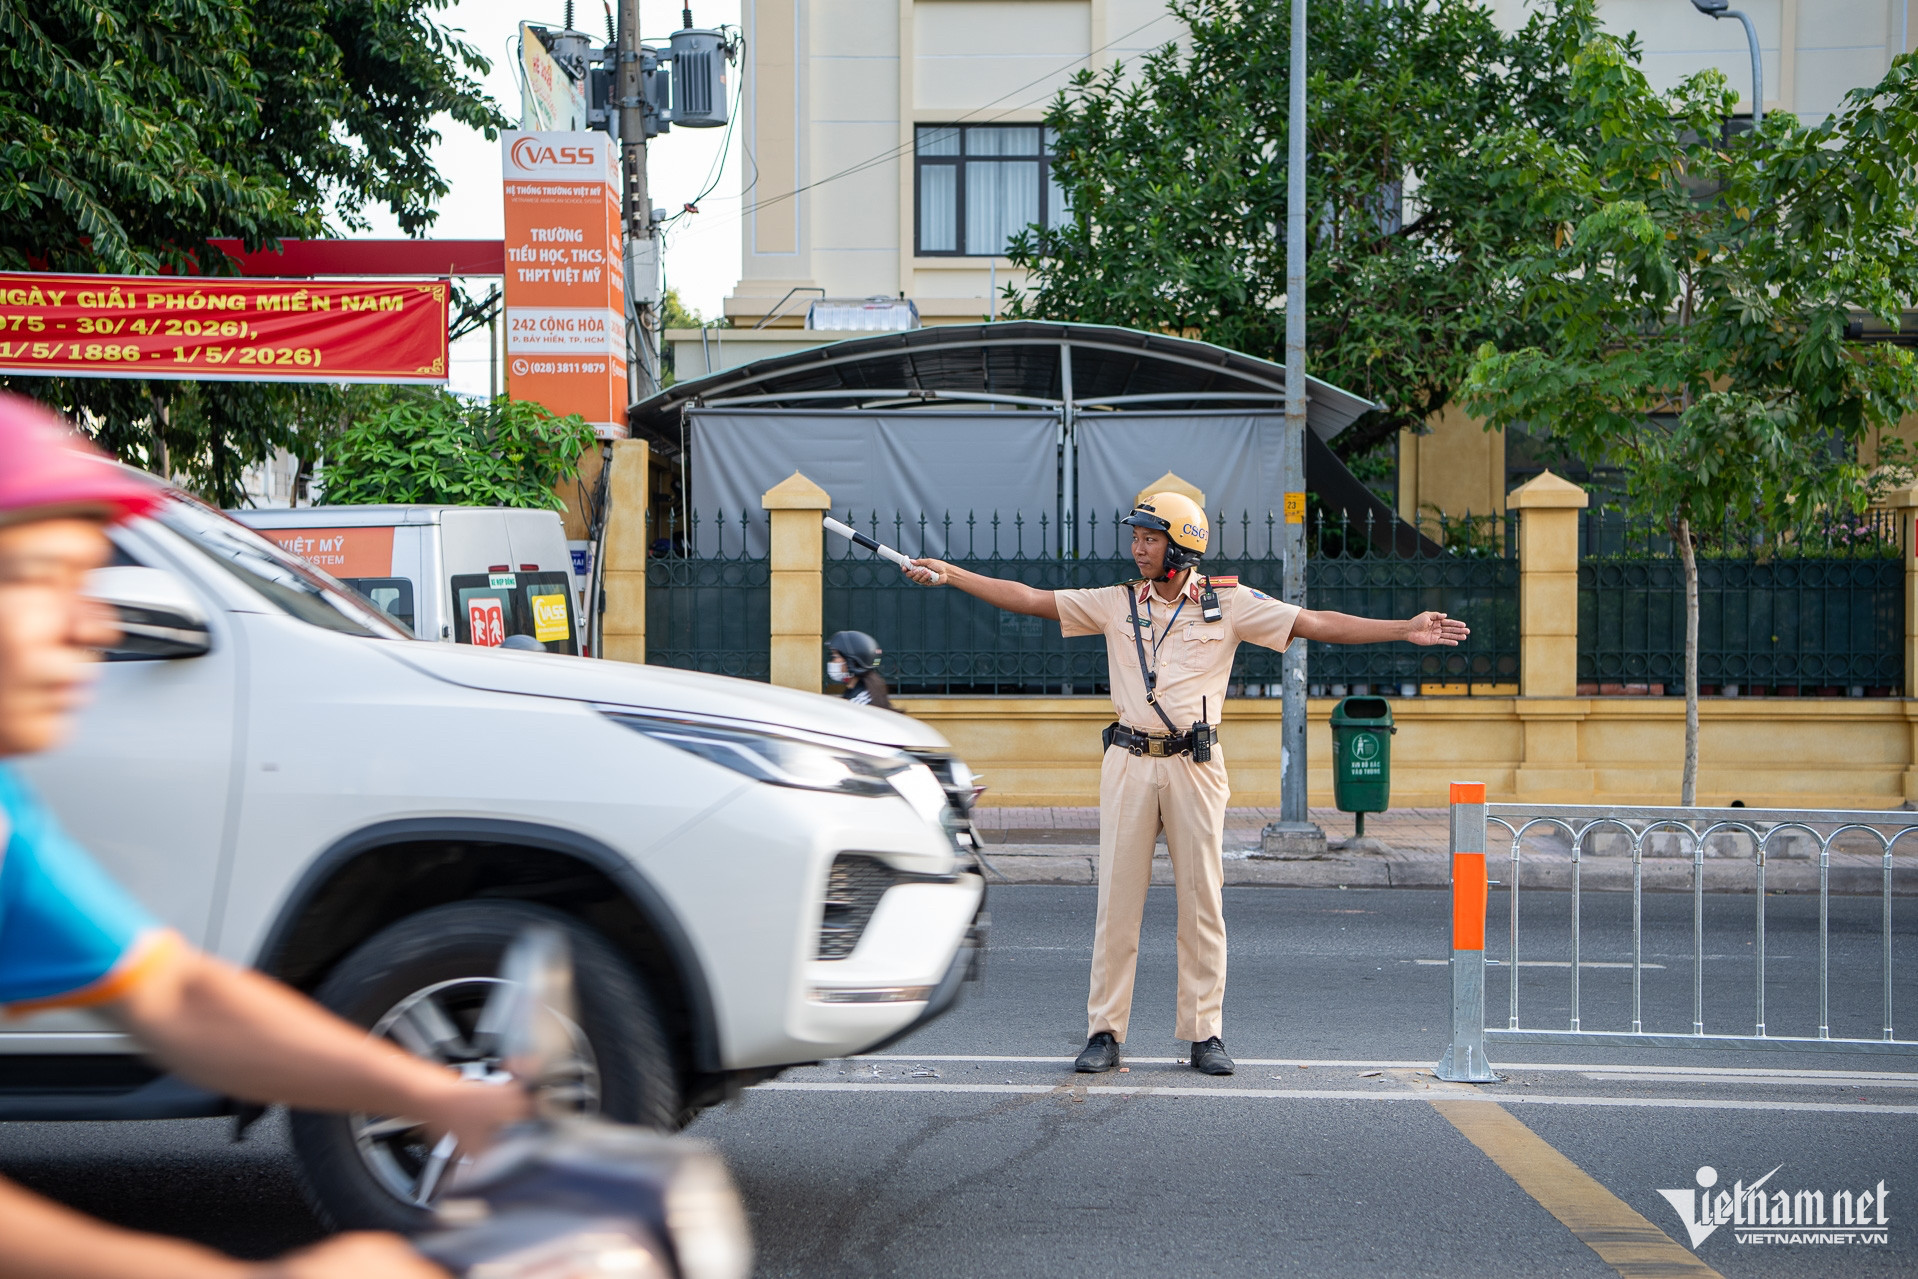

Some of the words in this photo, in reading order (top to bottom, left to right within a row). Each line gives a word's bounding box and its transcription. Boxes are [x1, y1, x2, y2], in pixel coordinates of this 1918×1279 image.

[525, 147, 594, 165] VASS
[506, 185, 515, 196] HỆ
[517, 184, 541, 195] THỐNG
[542, 185, 572, 196] TRƯỜNG
[573, 185, 589, 198] VIỆT
[530, 226, 583, 242] TRƯỜNG
[508, 244, 537, 262] TIỂU
[539, 249, 569, 266] HỌC,
[570, 249, 607, 265] THCS,
[517, 268, 550, 282] THPT
[552, 266, 579, 287] VIỆT
[582, 266, 601, 283] MỸ
[77, 286, 136, 309] GIẢI
[147, 290, 246, 311] PHÓNG
[256, 288, 330, 312] MIỀN
[341, 295, 404, 312] NAM
[76, 317, 258, 340] 30/4/2026),
[512, 318, 536, 331] 242
[539, 316, 574, 335] CỘNG
[578, 316, 605, 331] HÒA
[512, 336, 521, 344] P.
[172, 346, 322, 367] 1/5/2026)
[530, 362, 556, 375] (028)
[557, 363, 579, 373] 3811
[582, 363, 605, 374] 9879
[1288, 501, 1296, 509] 23
[278, 536, 315, 555] VIỆT
[319, 535, 344, 552] MỸ
[539, 604, 566, 620] VASS
